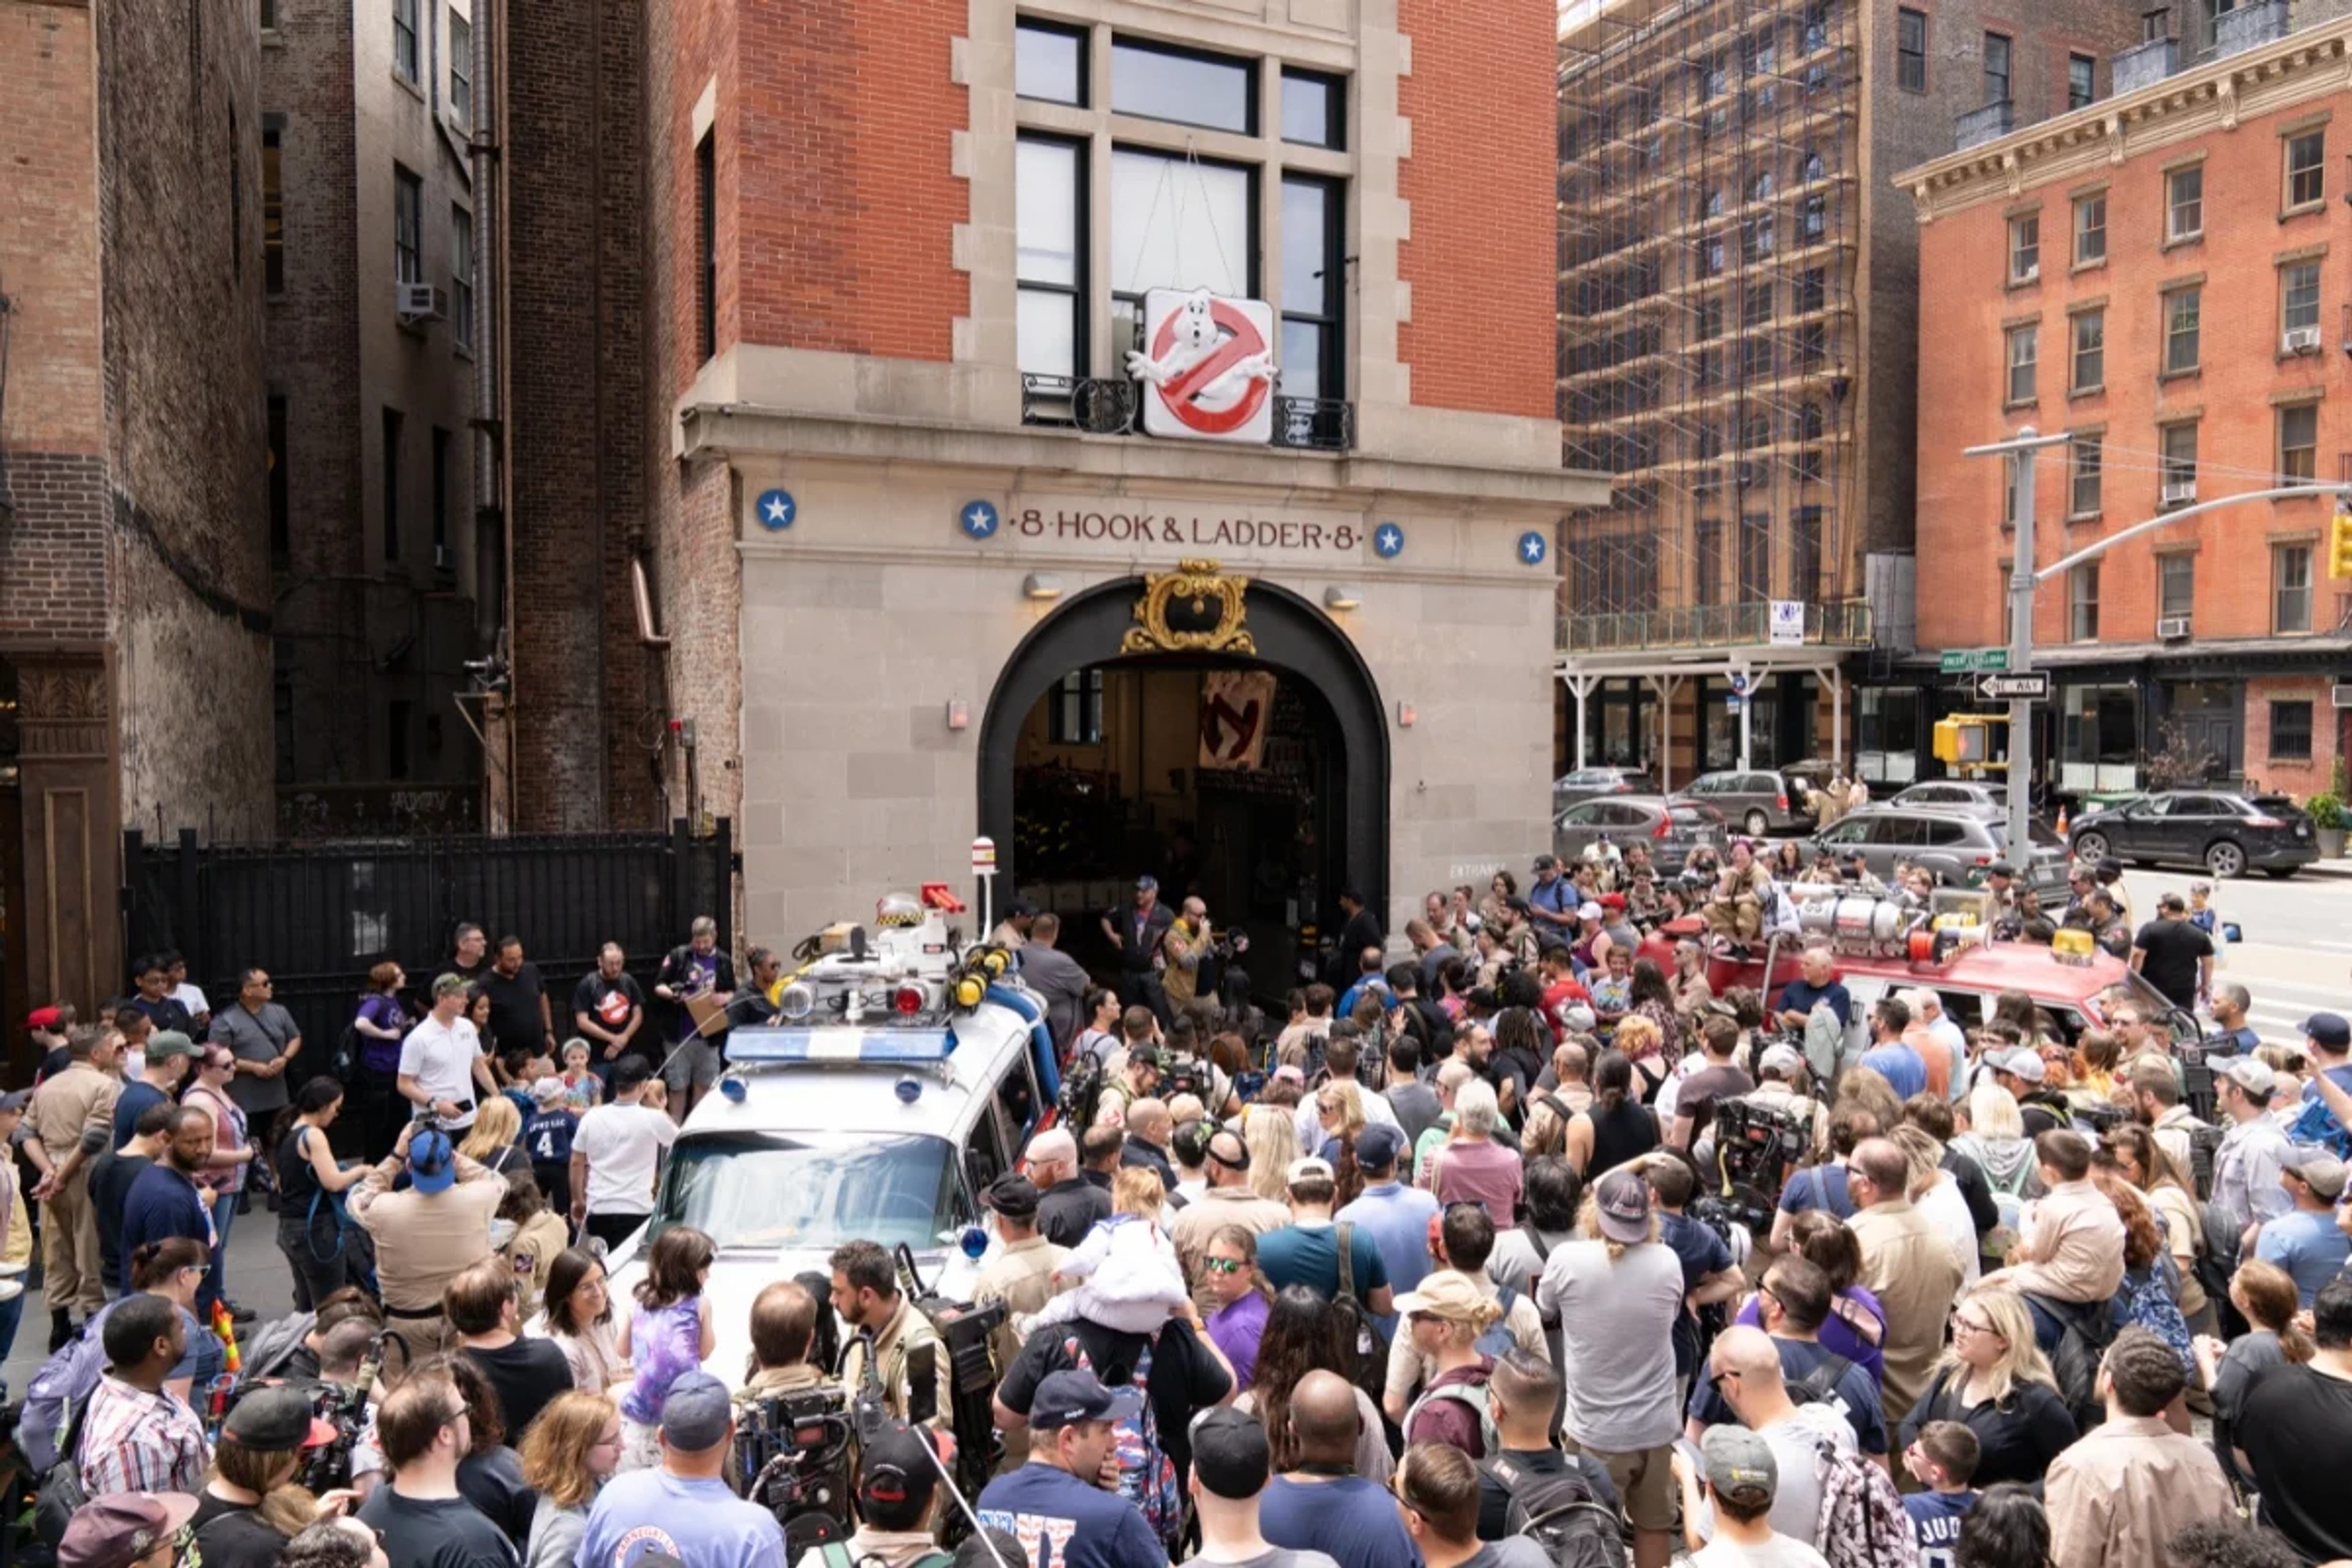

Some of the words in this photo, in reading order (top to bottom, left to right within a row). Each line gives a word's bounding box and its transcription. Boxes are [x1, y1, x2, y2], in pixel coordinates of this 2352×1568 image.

[1057, 511, 1155, 541] HOOK
[1163, 516, 1185, 543] &
[1192, 518, 1322, 549] LADDER
[1986, 680, 2006, 692] ONE
[2016, 679, 2038, 691] WAY
[537, 1131, 554, 1158] 4
